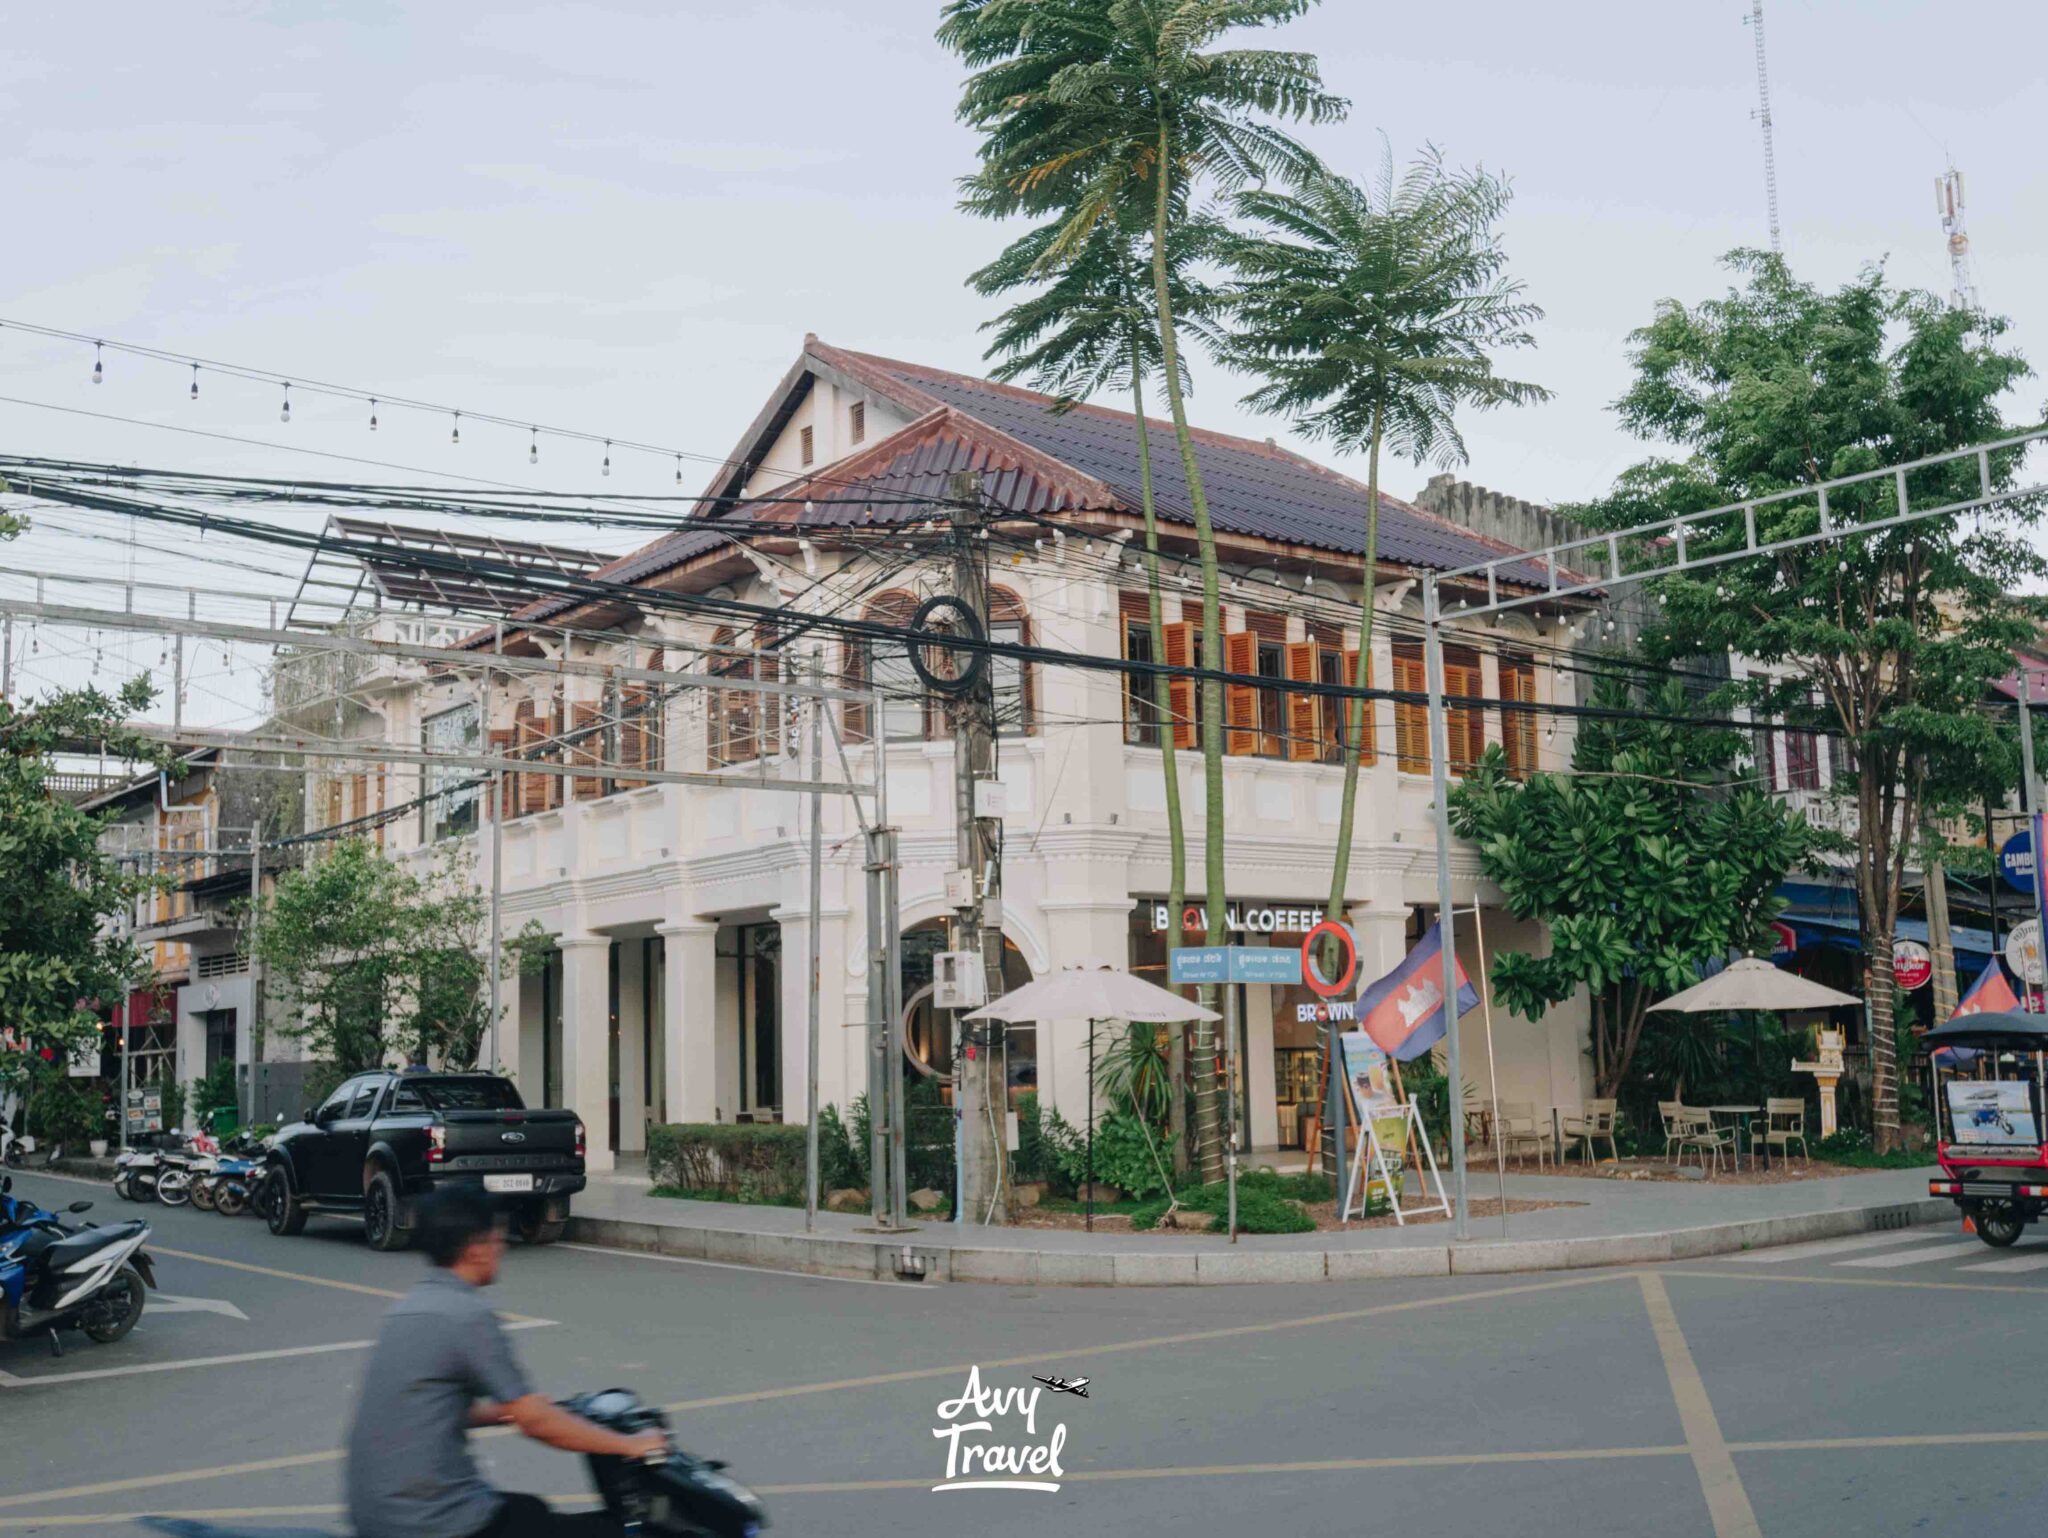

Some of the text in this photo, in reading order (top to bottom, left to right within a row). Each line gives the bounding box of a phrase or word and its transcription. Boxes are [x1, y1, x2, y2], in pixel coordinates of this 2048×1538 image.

[1156, 906, 1323, 932] BON COFFEE
[1297, 1001, 1354, 1022] BROWN
